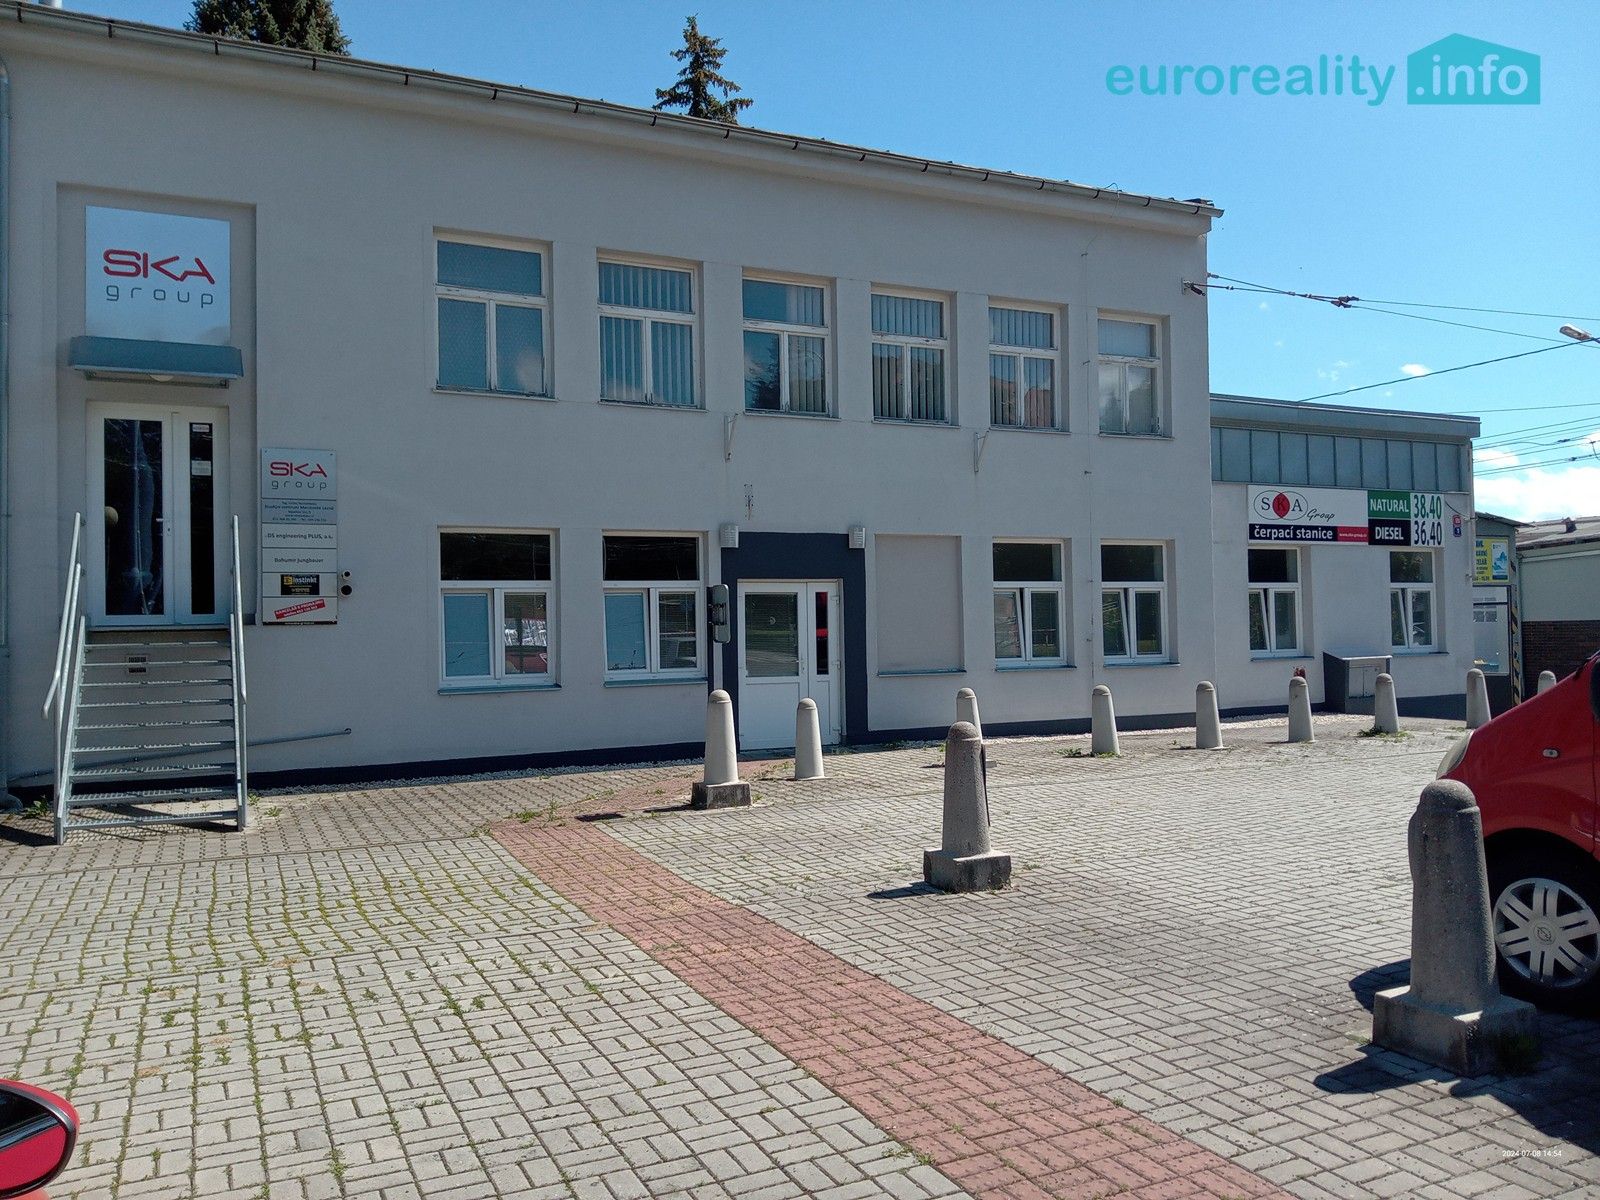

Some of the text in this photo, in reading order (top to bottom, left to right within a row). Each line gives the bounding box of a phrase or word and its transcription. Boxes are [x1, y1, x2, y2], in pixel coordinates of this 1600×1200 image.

[102, 248, 216, 285] SKA
[105, 284, 215, 309] group
[270, 461, 328, 478] SKA
[271, 480, 328, 491] group
[1261, 496, 1336, 522] SKA Group
[1369, 498, 1410, 513] NATURAL
[1413, 494, 1442, 519] 38.40
[1254, 525, 1334, 541] čerpací stanice
[1374, 526, 1404, 541] DIESEL
[1413, 520, 1443, 546] 36.40
